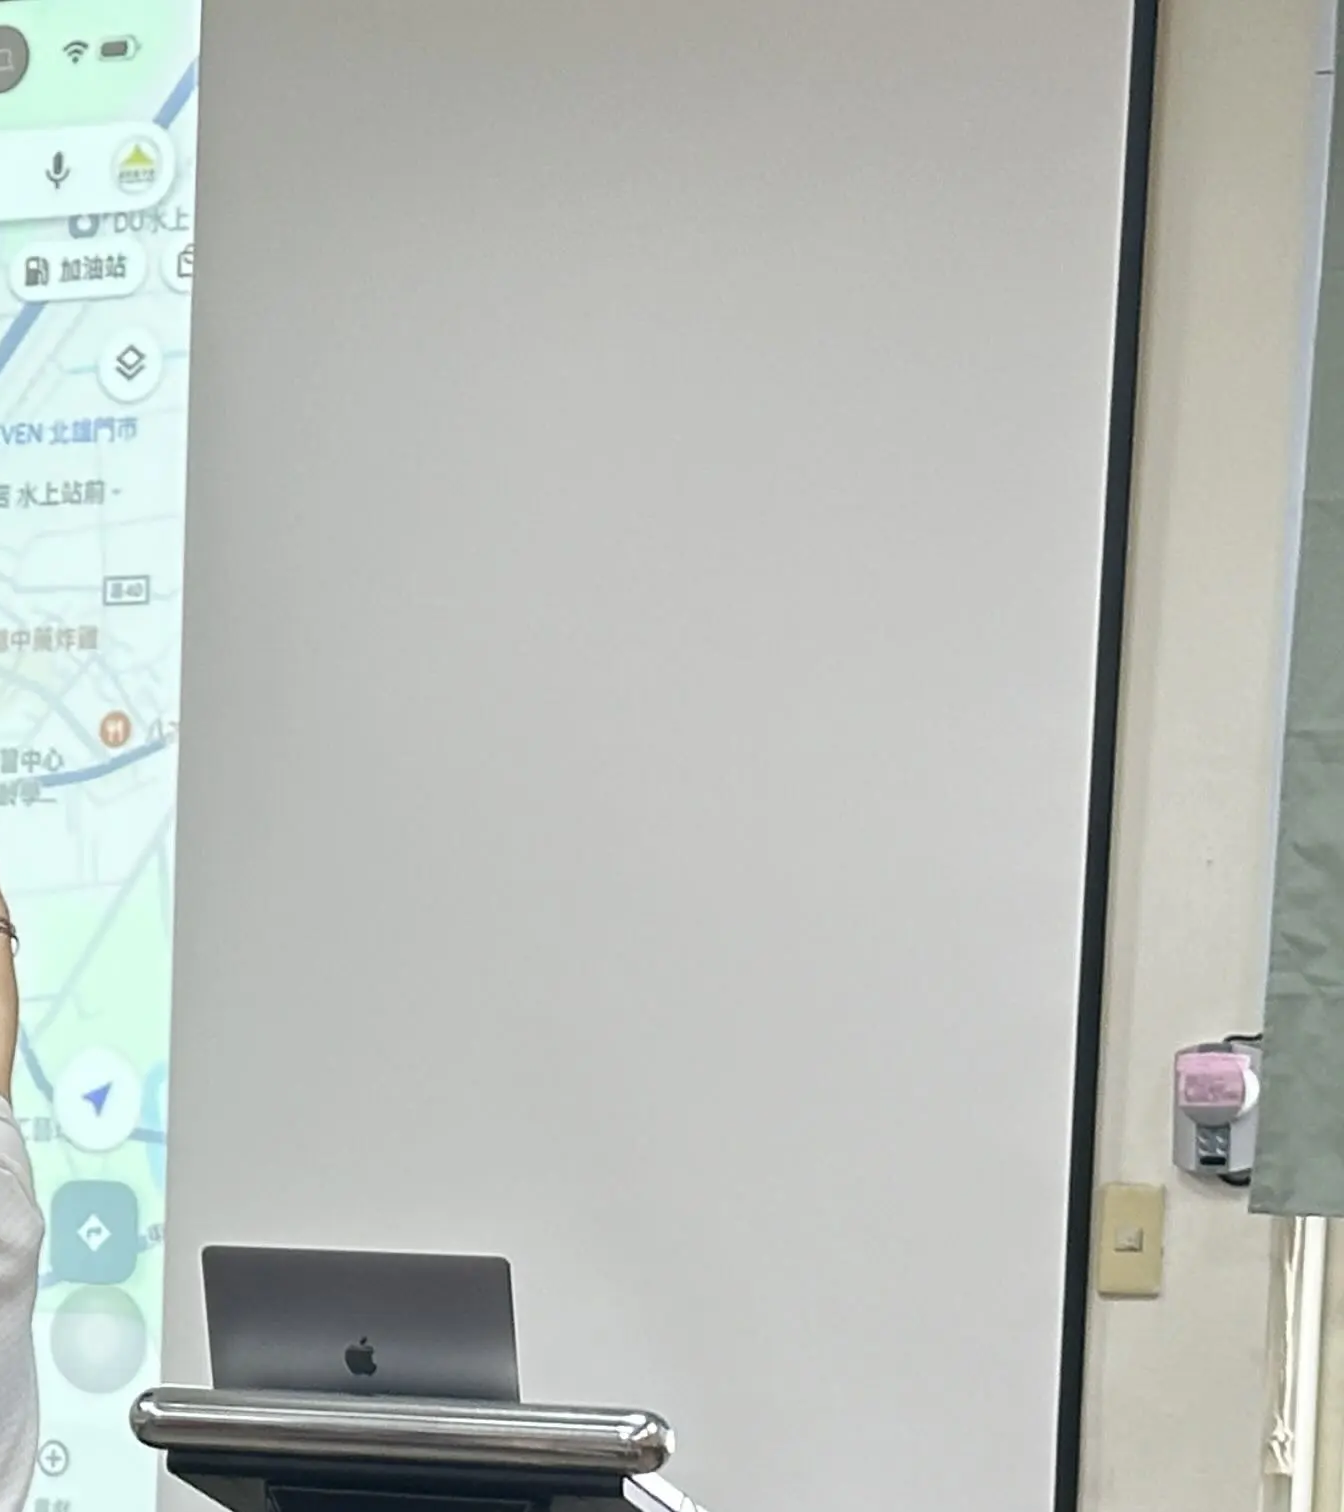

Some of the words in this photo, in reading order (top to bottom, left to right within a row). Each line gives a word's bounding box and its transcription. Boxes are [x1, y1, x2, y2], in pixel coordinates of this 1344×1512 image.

[58, 254, 127, 283] 加油站
[16, 479, 106, 509] 水上站前
